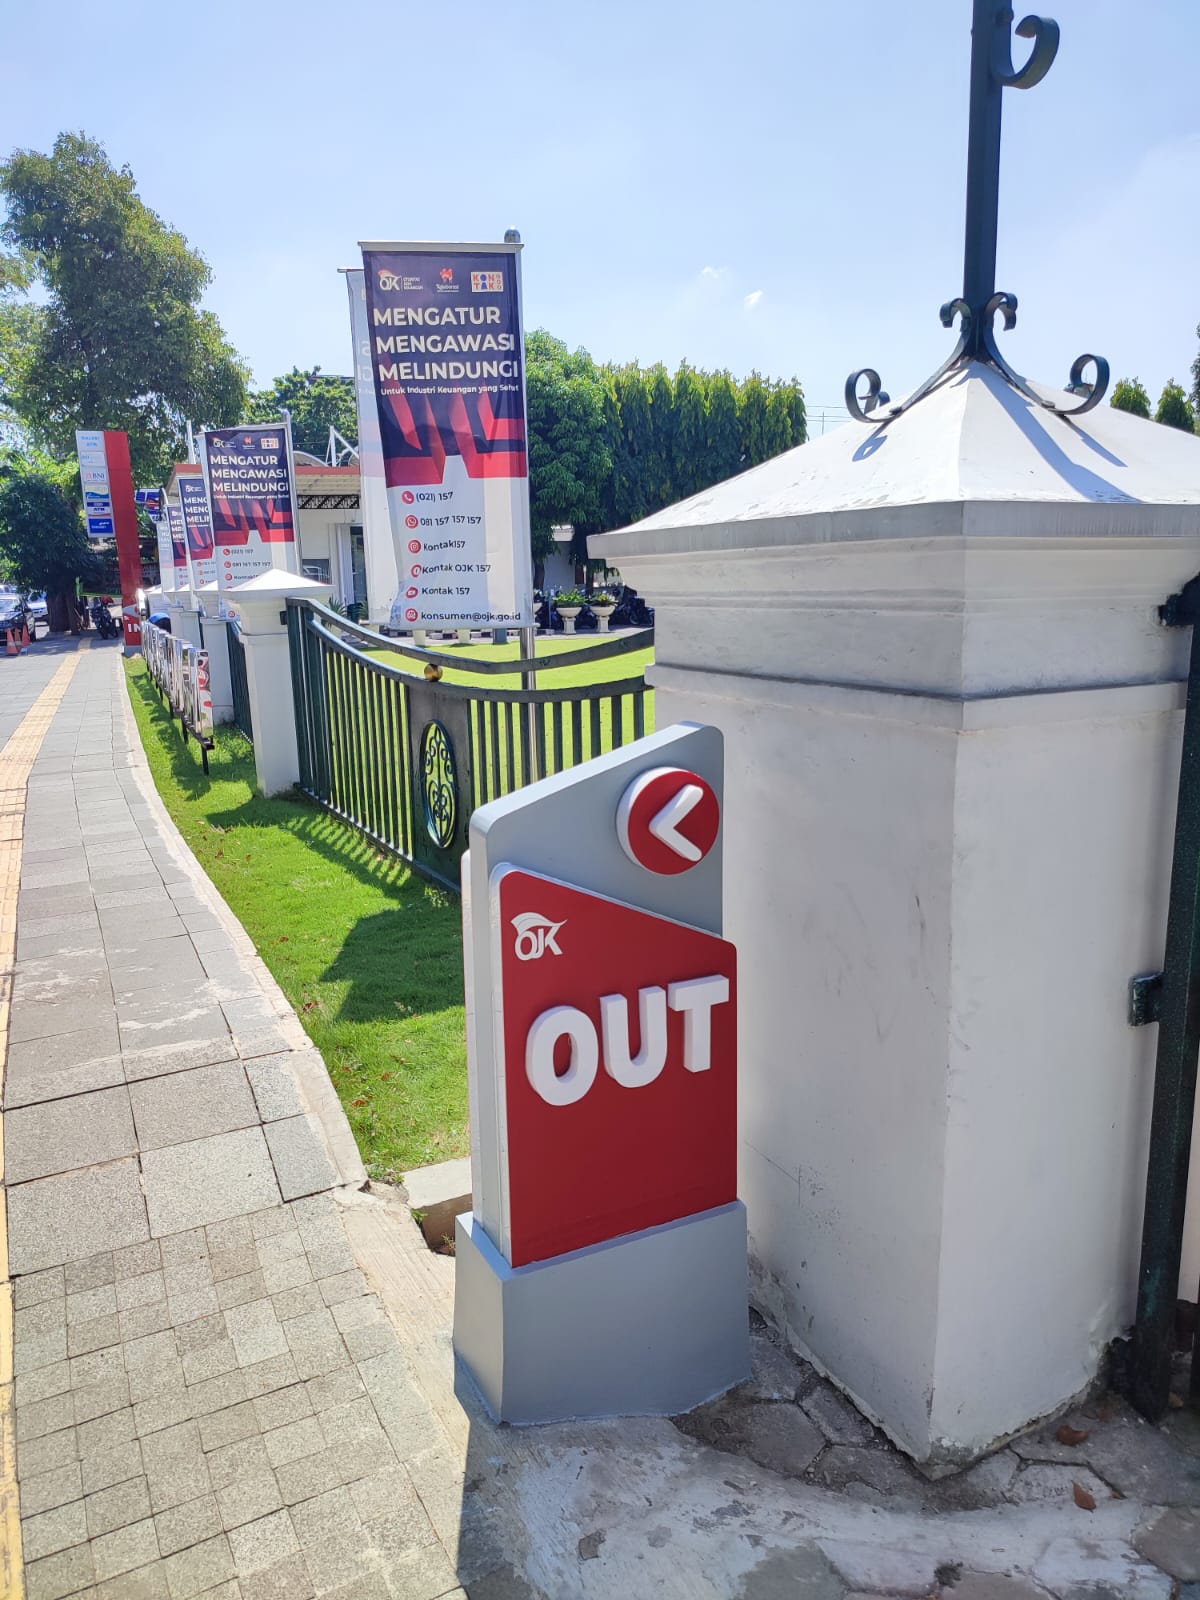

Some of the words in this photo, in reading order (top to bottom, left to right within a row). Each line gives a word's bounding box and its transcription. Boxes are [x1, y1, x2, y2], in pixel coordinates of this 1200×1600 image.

[373, 306, 501, 326] MENGATUR
[375, 333, 515, 354] MENGAWASI
[378, 360, 519, 382] MELINDUNGI
[380, 388, 406, 396] Untuk
[407, 386, 436, 394] Industri
[437, 385, 477, 395] Keuangan
[478, 385, 498, 394] yang
[209, 455, 278, 466] MENGATUR
[211, 468, 287, 479] MENGAWASI
[212, 482, 289, 492] MELINDUNGI
[415, 492, 436, 503] (021)
[438, 491, 454, 501] 157
[420, 517, 433, 527] 081
[434, 515, 450, 527] 157
[451, 515, 466, 524] 157
[466, 515, 482, 525] 157
[423, 539, 466, 552] Kontak157
[422, 563, 453, 575] Kontak
[454, 564, 474, 573] OJK
[476, 564, 492, 573] 157
[421, 586, 454, 595] Kontak
[455, 586, 470, 596] 157
[420, 611, 521, 623] konsumen@ojk.go.id
[513, 920, 565, 961] OJK
[524, 973, 730, 1107] OUT
